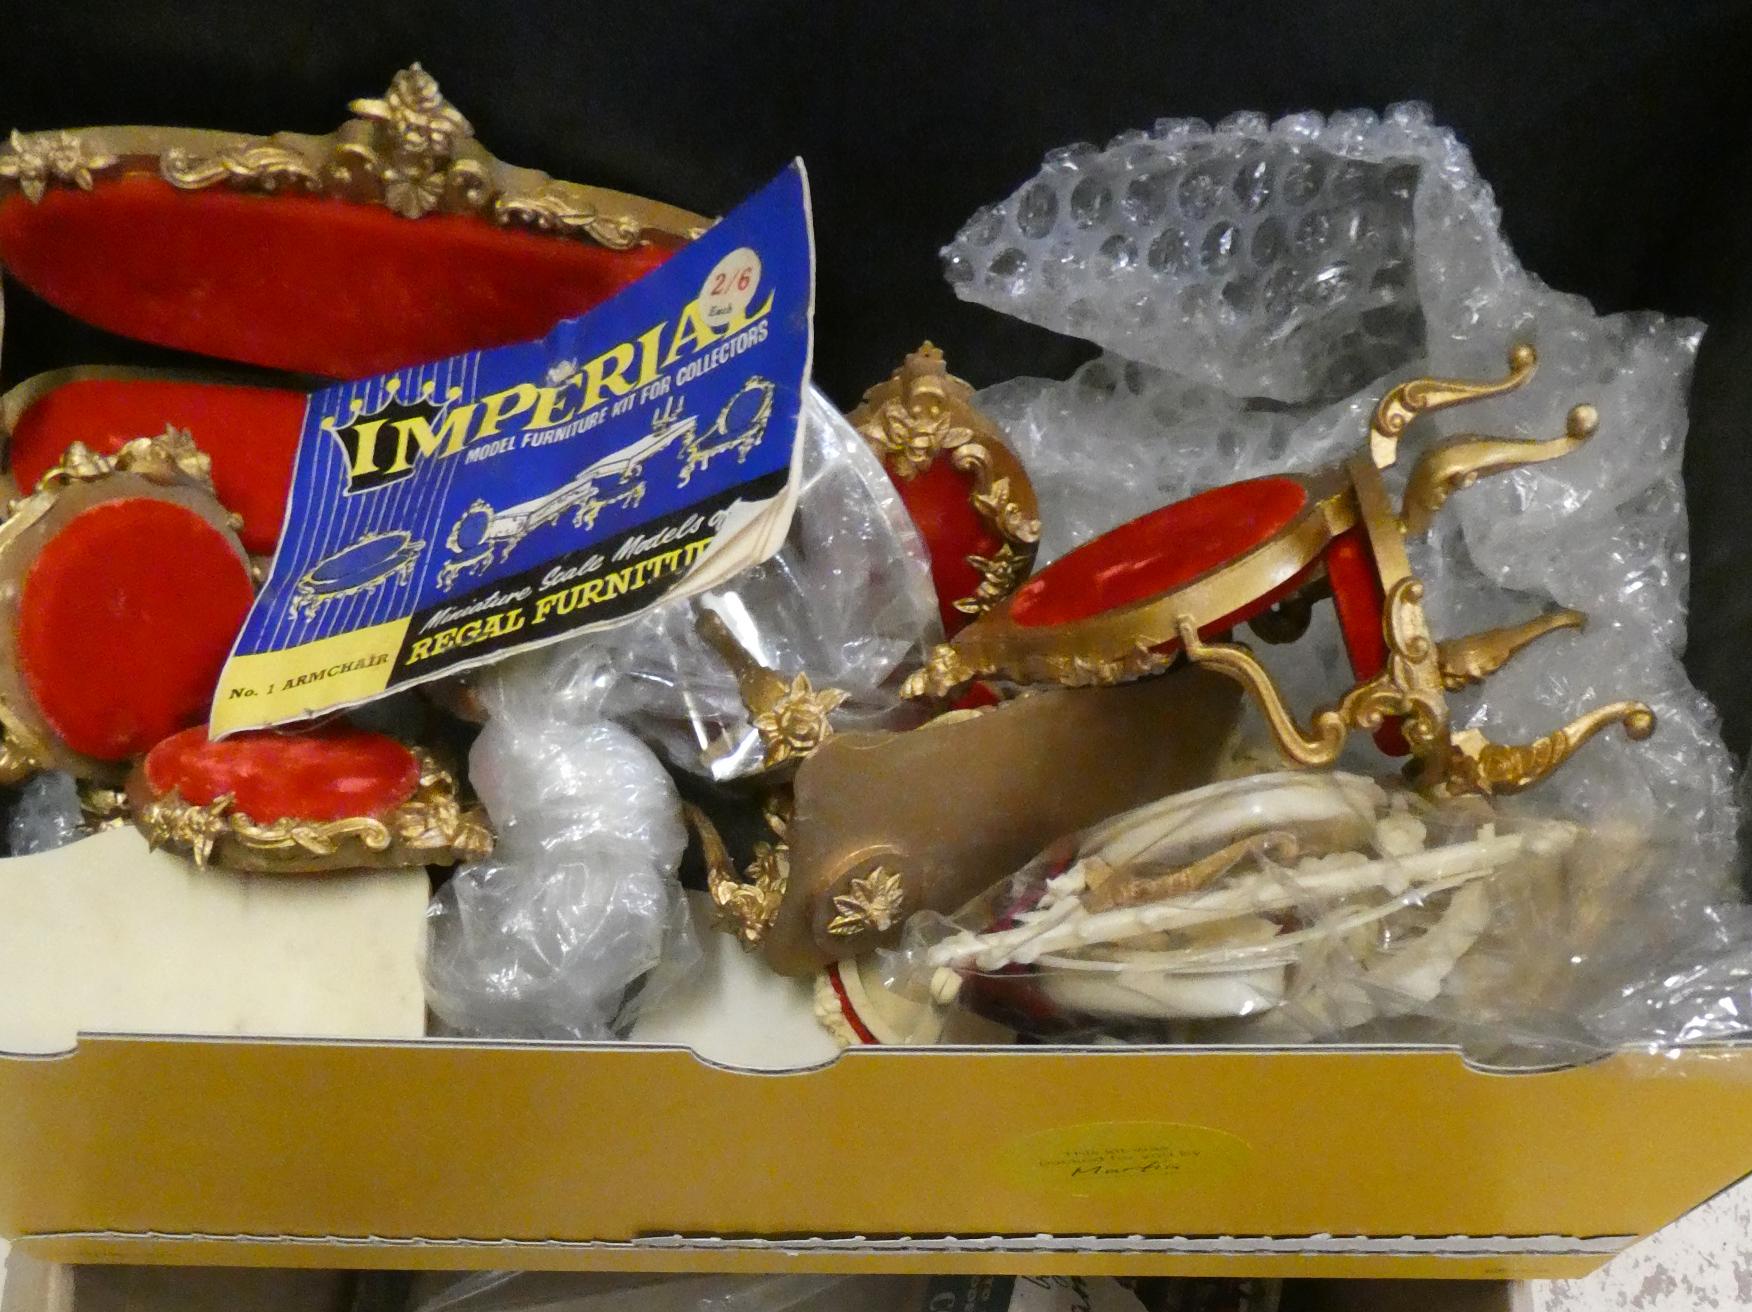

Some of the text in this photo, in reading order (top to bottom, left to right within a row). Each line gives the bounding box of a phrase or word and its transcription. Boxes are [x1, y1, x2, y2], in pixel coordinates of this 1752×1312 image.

[711, 267, 753, 296] 2/6
[350, 287, 776, 478] IMPERIAL
[465, 320, 769, 465] MODEL FURNITURE KIT FOR COLLECTORS
[418, 584, 533, 635] Miniature
[538, 552, 605, 592] Scale
[612, 512, 706, 562] Models
[229, 652, 390, 700] No. 1 ARMCHAIR
[405, 606, 527, 666] REGAL
